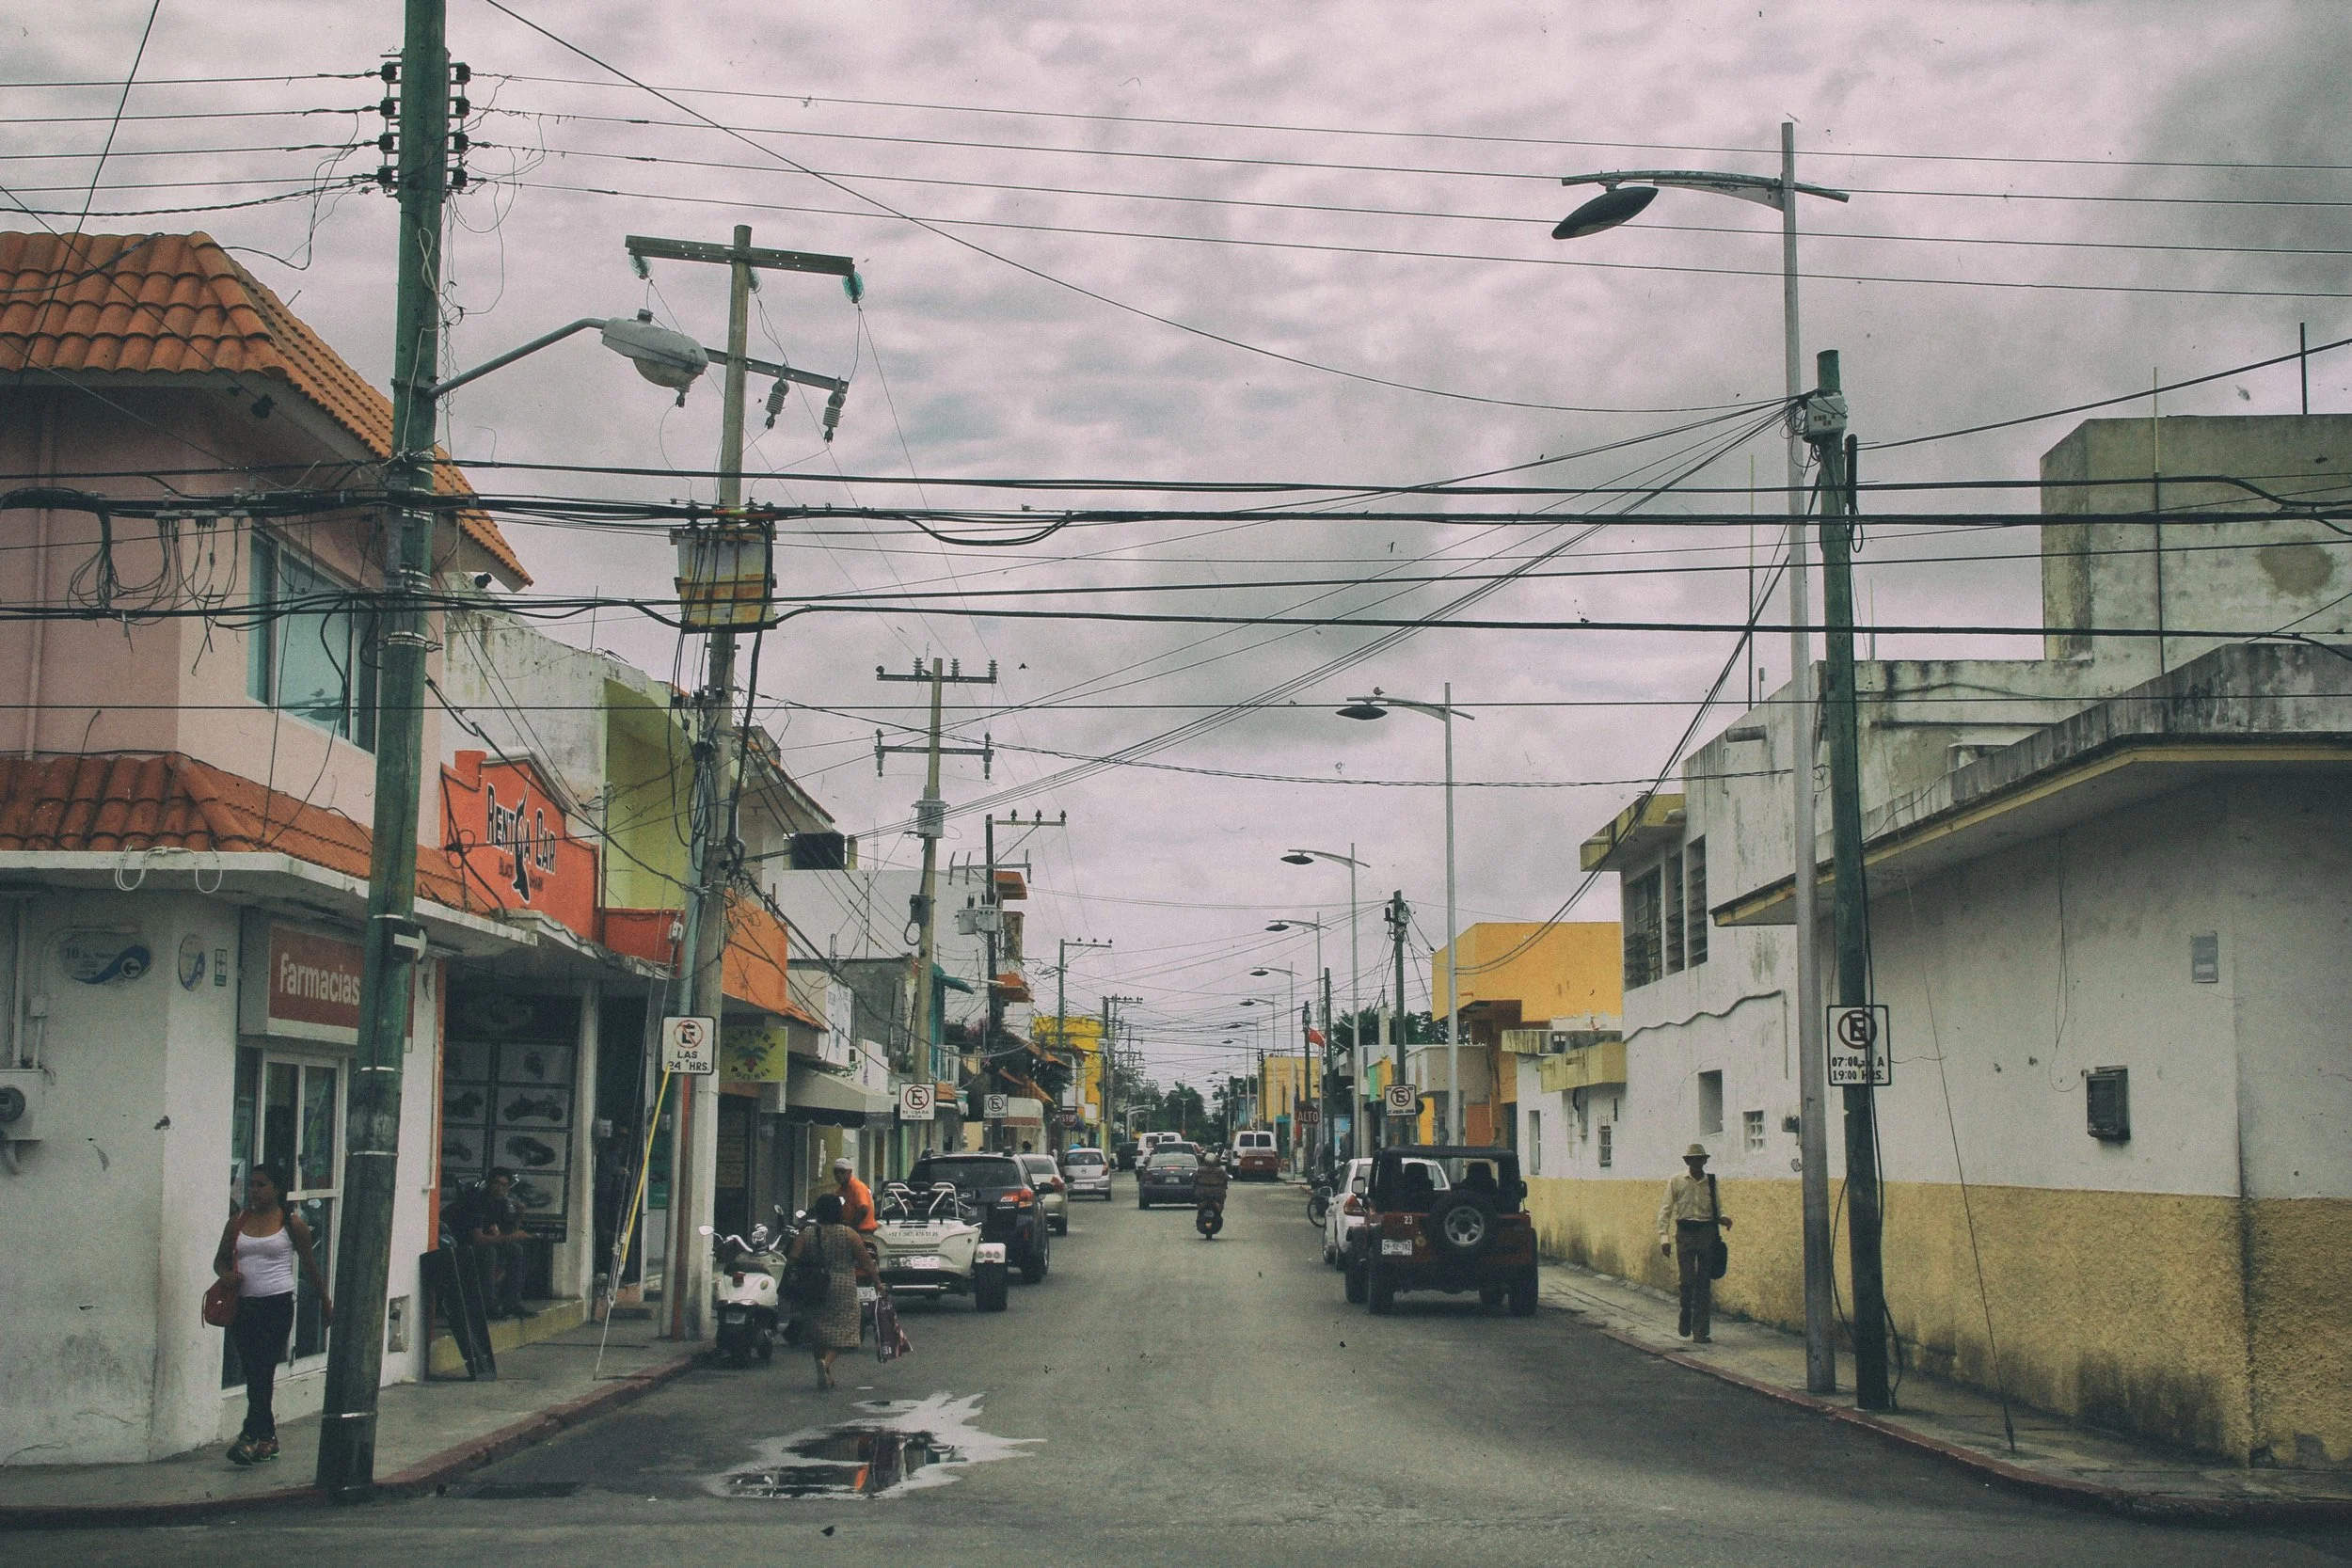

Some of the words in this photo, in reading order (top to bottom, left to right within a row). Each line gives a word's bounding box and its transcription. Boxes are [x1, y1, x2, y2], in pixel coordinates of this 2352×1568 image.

[485, 782, 516, 856] RENT
[535, 806, 556, 876] CAR
[279, 952, 360, 1006] farmacias
[677, 1051, 698, 1059] LAS
[667, 1061, 681, 1070] 24
[689, 1061, 709, 1071] HRS.
[1831, 1055, 1858, 1068] 07:00
[1833, 1069, 1857, 1081] 19:00
[1061, 1113, 1075, 1122] STOP
[1297, 1111, 1318, 1122] ALTO
[1404, 1215, 1413, 1225] 23
